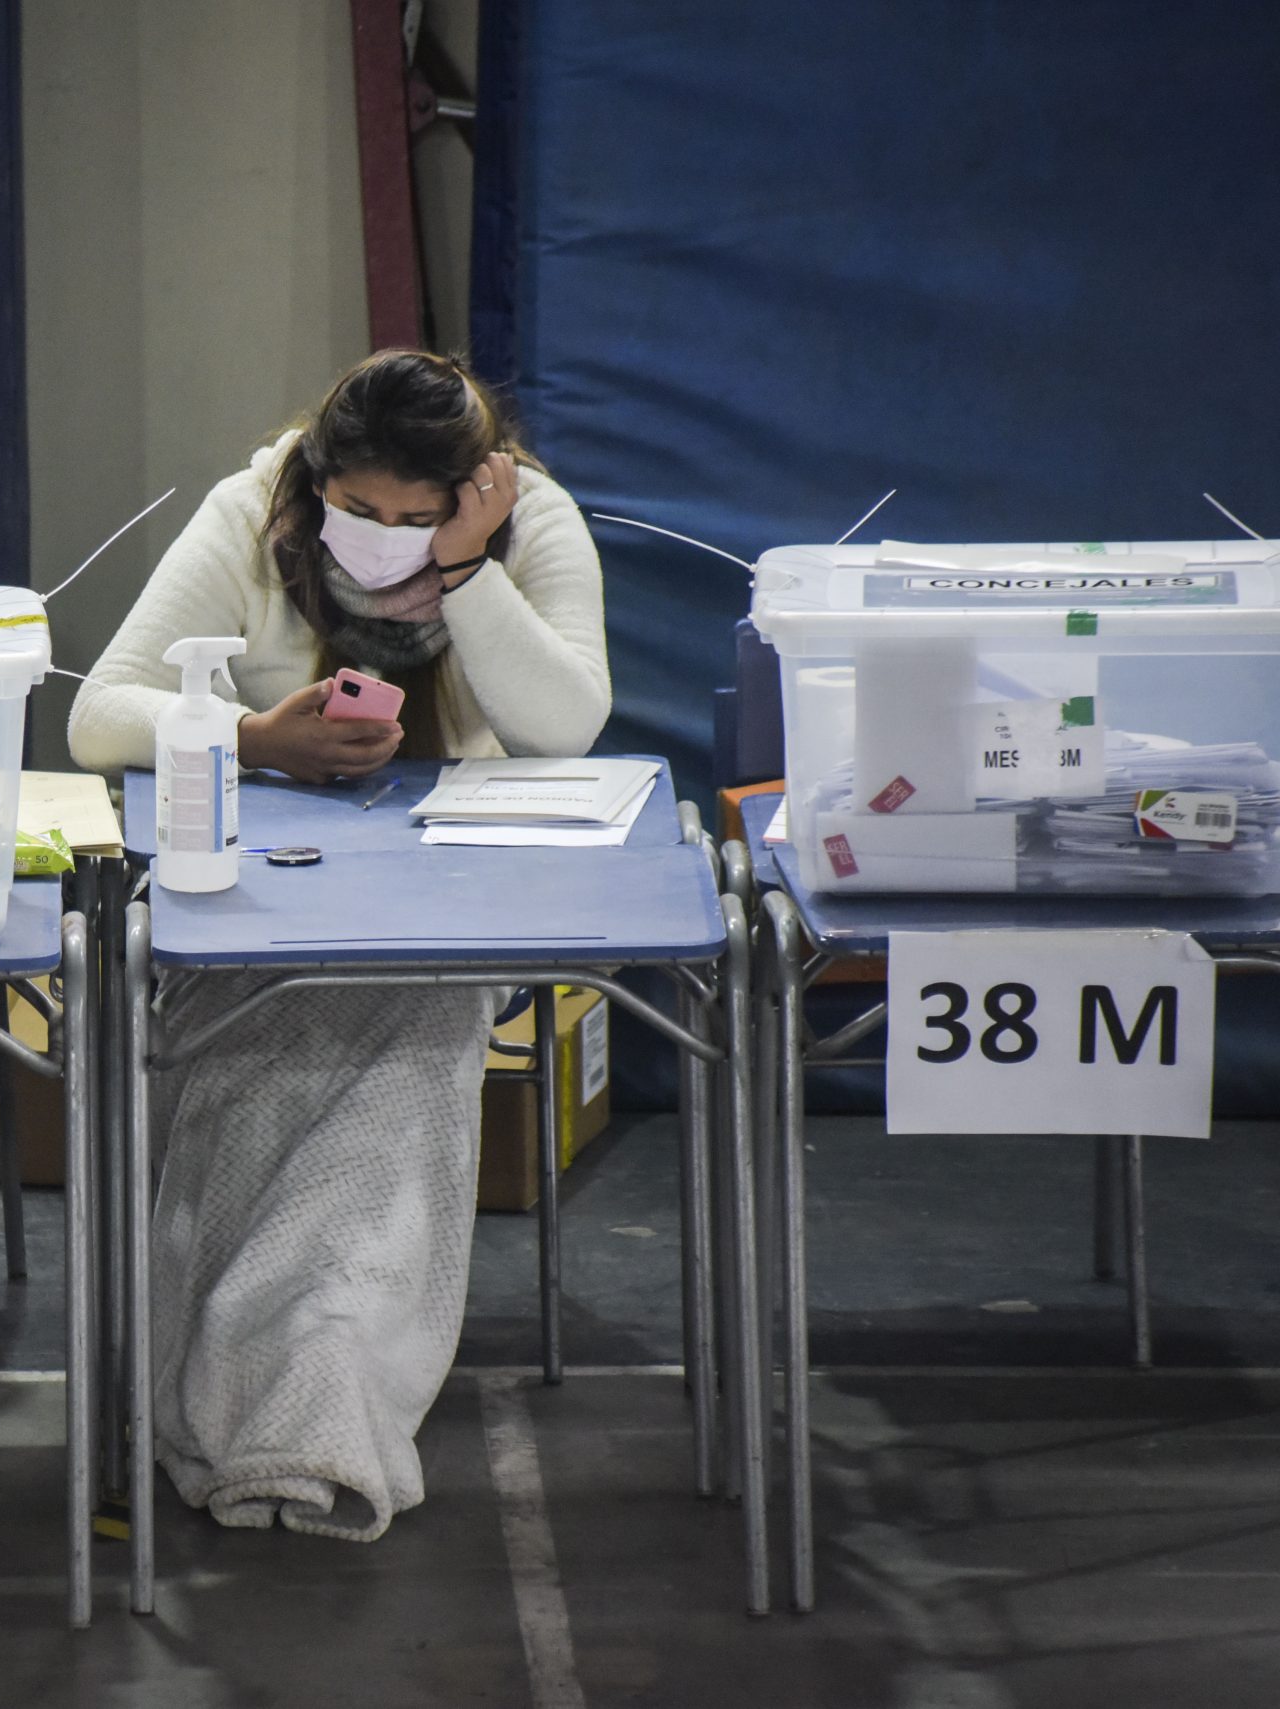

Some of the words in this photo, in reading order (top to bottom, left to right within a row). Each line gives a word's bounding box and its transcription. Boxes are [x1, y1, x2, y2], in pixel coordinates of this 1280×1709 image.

[929, 577, 1194, 589] CONCEJALES
[984, 750, 1020, 768] MES
[35, 855, 49, 864] 50
[917, 981, 1039, 1064] 38
[1078, 984, 1178, 1066] M
